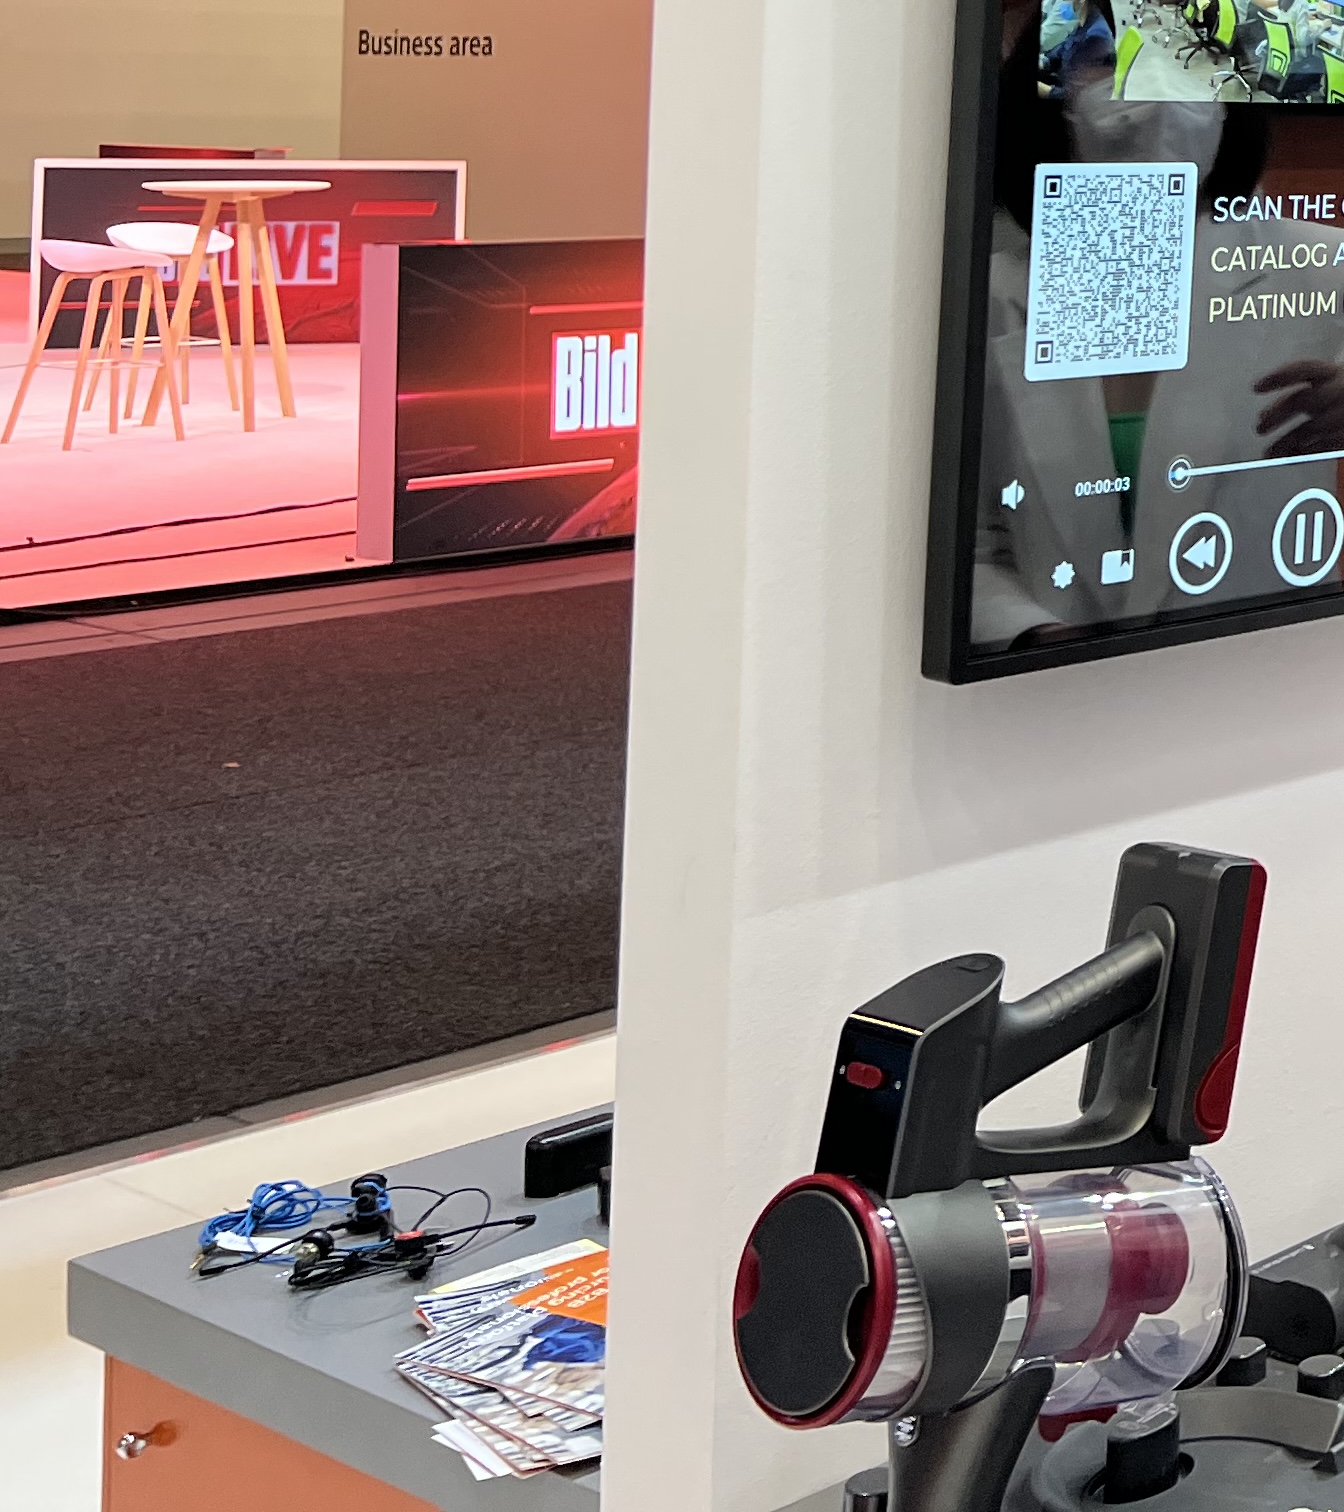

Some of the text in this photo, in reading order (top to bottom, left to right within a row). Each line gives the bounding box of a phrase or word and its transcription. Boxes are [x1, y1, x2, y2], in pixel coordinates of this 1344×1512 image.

[358, 28, 493, 57] Business area
[1213, 195, 1283, 223] SCAN
[1288, 193, 1337, 220] THE
[1210, 242, 1328, 273] CATALOG
[1208, 290, 1337, 324] PLATINUM
[555, 332, 638, 433] Bild
[1074, 476, 1131, 498] 00:00:03
